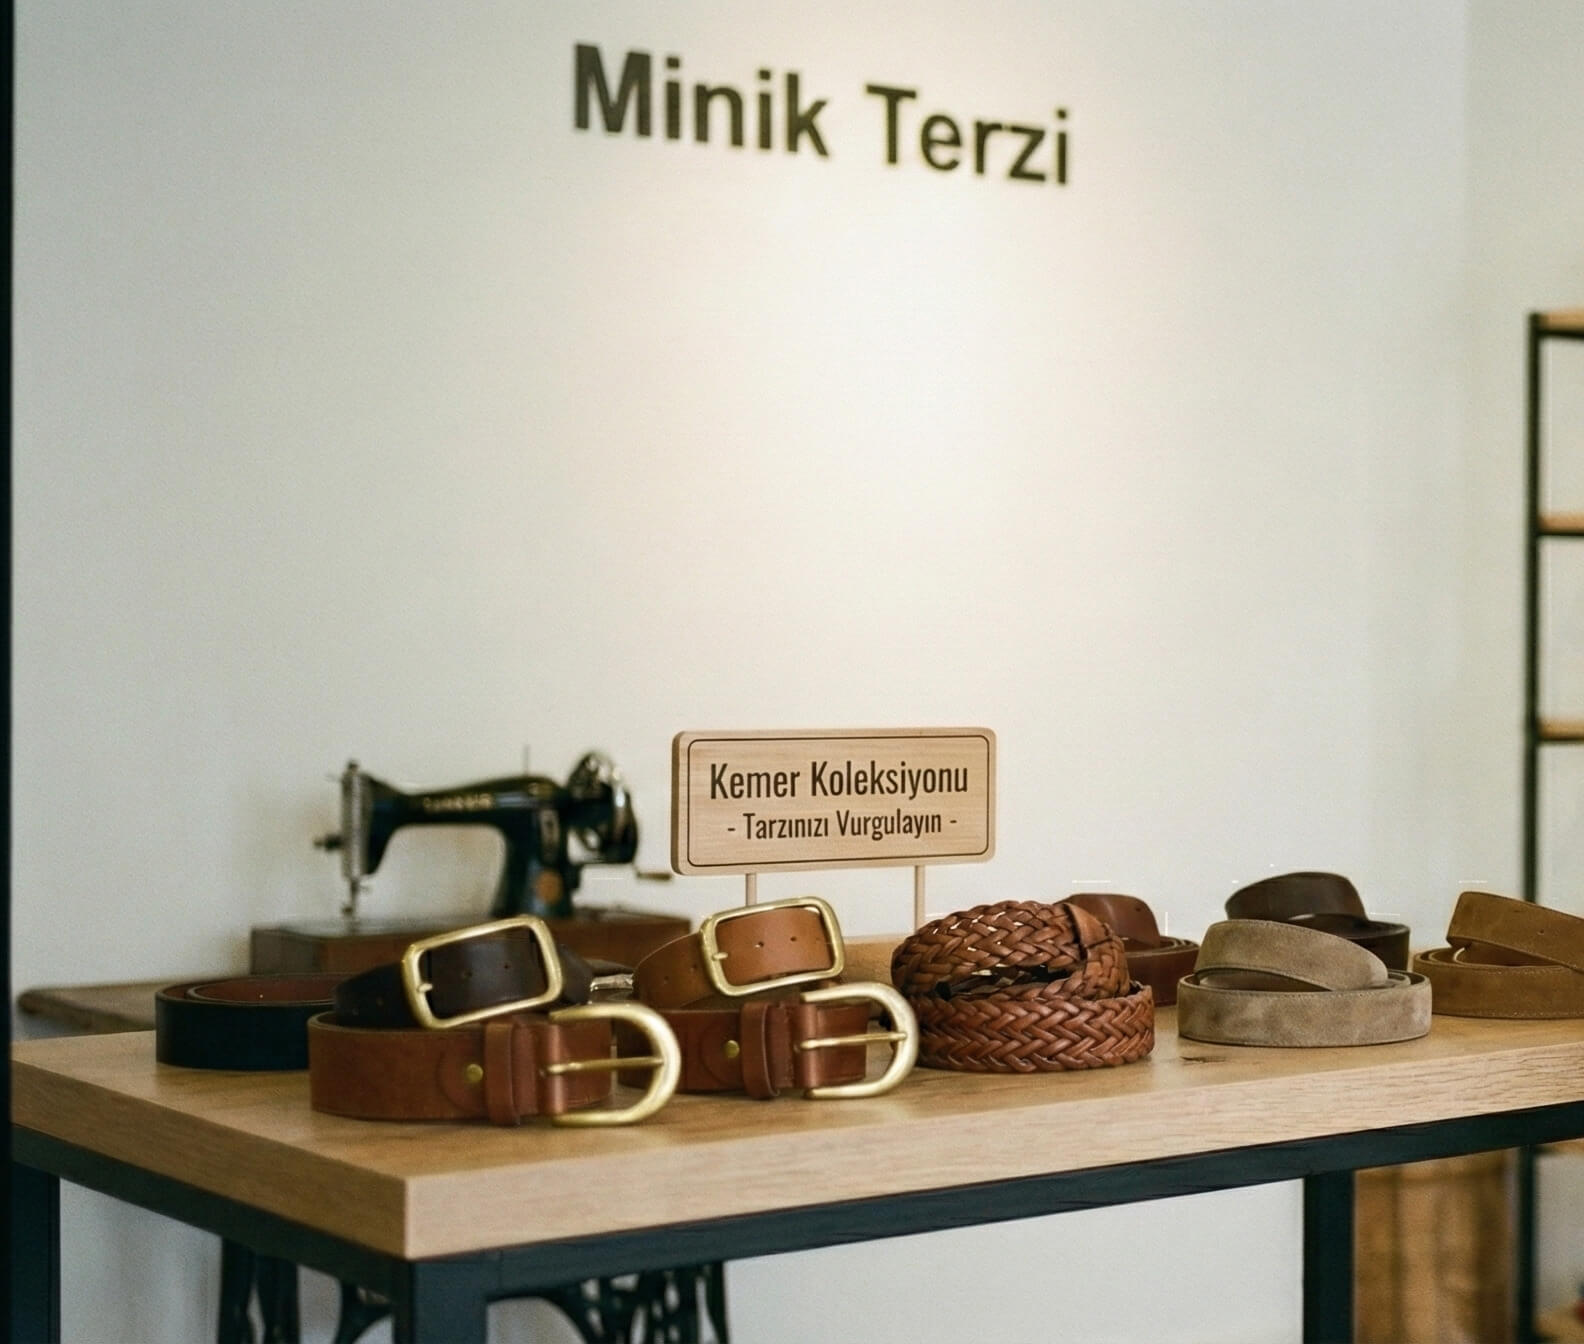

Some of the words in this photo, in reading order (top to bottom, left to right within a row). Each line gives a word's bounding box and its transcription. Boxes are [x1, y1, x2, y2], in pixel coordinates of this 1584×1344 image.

[574, 43, 829, 157] Minik
[865, 84, 1068, 186] Terzi
[710, 763, 801, 800] Kemer
[811, 760, 968, 800] Koleksiyonu
[742, 812, 829, 840] Tarzınızı
[836, 808, 942, 841] Vurgulayın
